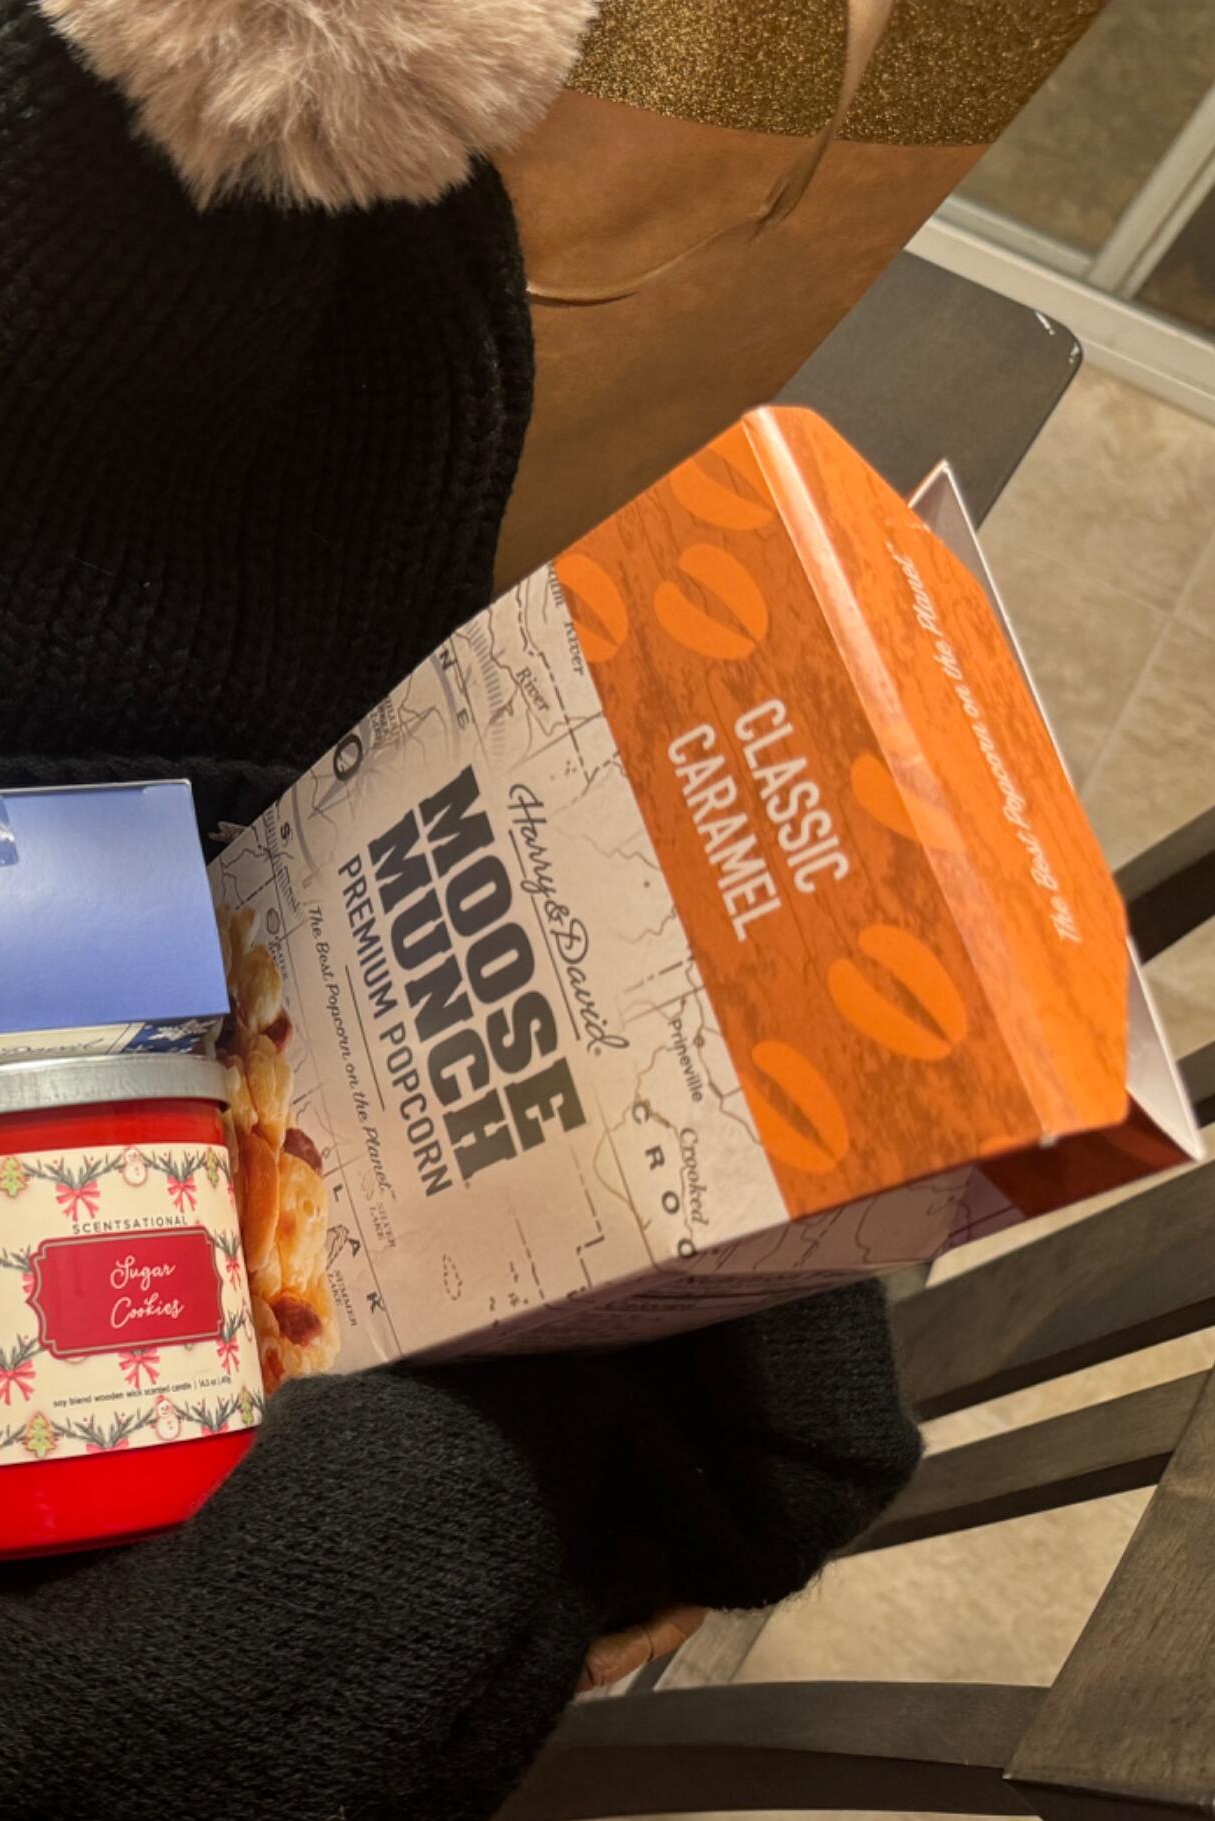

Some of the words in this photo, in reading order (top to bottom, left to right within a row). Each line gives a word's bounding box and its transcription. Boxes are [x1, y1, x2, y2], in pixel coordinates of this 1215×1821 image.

[932, 640, 962, 681] the
[517, 667, 550, 712] River
[955, 684, 979, 719] on
[734, 697, 850, 895] CLASSIC
[973, 723, 1031, 830] Popcorn
[667, 723, 783, 943] CARAMEL
[1016, 833, 1058, 891] Best
[1050, 894, 1081, 943] The
[417, 764, 585, 1153] MOOSE
[308, 905, 322, 940] The
[315, 941, 334, 983] Best
[327, 983, 352, 1062] Popcorn
[345, 1062, 359, 1091] on
[352, 1090, 370, 1125] the
[368, 809, 520, 1179] MUNCH
[338, 854, 399, 1020] PREMIUM
[380, 1021, 453, 1198] POPCORN
[668, 1017, 703, 1103] Prineville
[680, 1128, 709, 1226] Crooked
[72, 1216, 187, 1235] SCENTSATIONAL
[369, 1206, 385, 1241] LAKE
[377, 1202, 397, 1248] SILVER
[110, 1255, 176, 1291] Sugar
[334, 1270, 358, 1327] SUMMER
[111, 1292, 184, 1329] Cookies
[53, 1399, 67, 1408] soy
[69, 1395, 92, 1406] blend
[94, 1391, 124, 1402] wooden
[126, 1389, 143, 1398] wick
[144, 1385, 170, 1396] scented
[172, 1382, 192, 1392] candle
